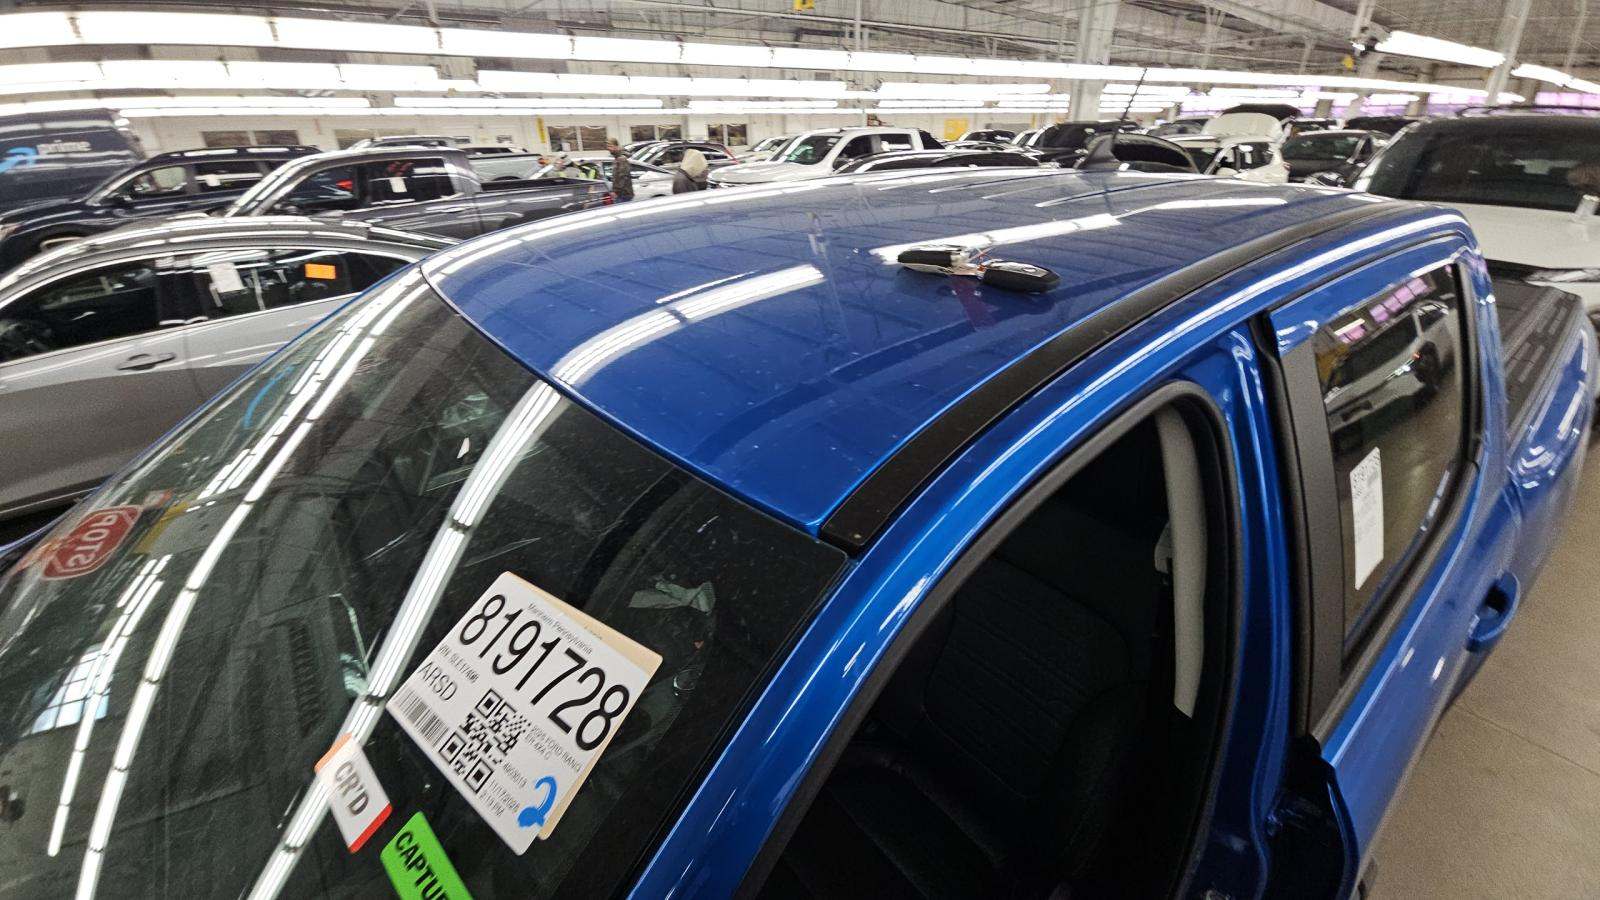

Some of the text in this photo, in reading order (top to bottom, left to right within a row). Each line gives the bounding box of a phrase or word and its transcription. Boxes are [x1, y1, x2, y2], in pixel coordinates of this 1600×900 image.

[37, 139, 92, 156] prime
[417, 661, 458, 701] ARSD
[460, 594, 630, 751] 8191728
[517, 776, 557, 828] 2
